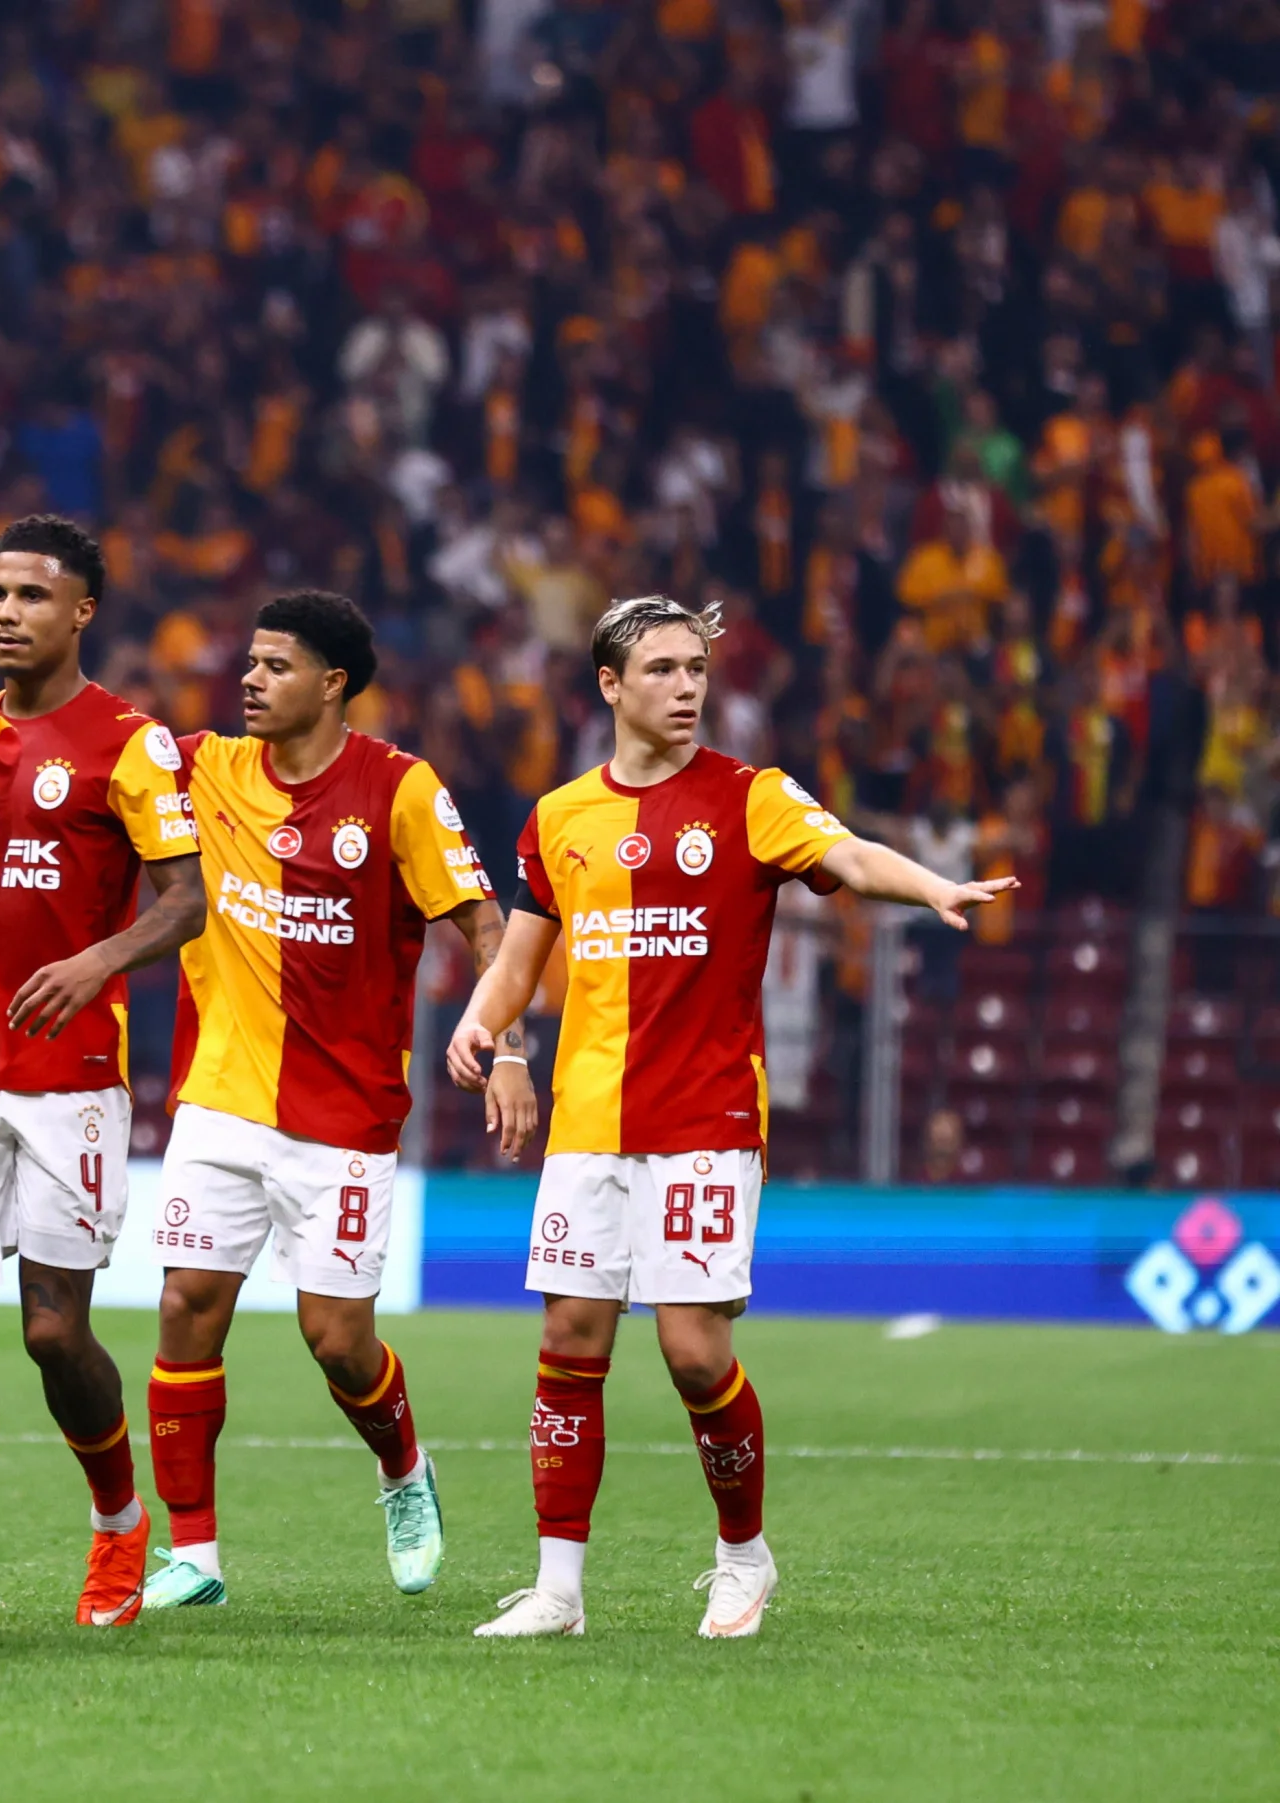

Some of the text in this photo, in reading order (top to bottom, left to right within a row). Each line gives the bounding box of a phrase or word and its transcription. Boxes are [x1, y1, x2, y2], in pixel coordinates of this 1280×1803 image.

[80, 1153, 102, 1212] 4
[336, 1186, 369, 1242] 8
[664, 1183, 735, 1244] 83
[152, 1229, 214, 1250] EGES
[155, 1420, 180, 1436] GS
[536, 1456, 563, 1468] GS
